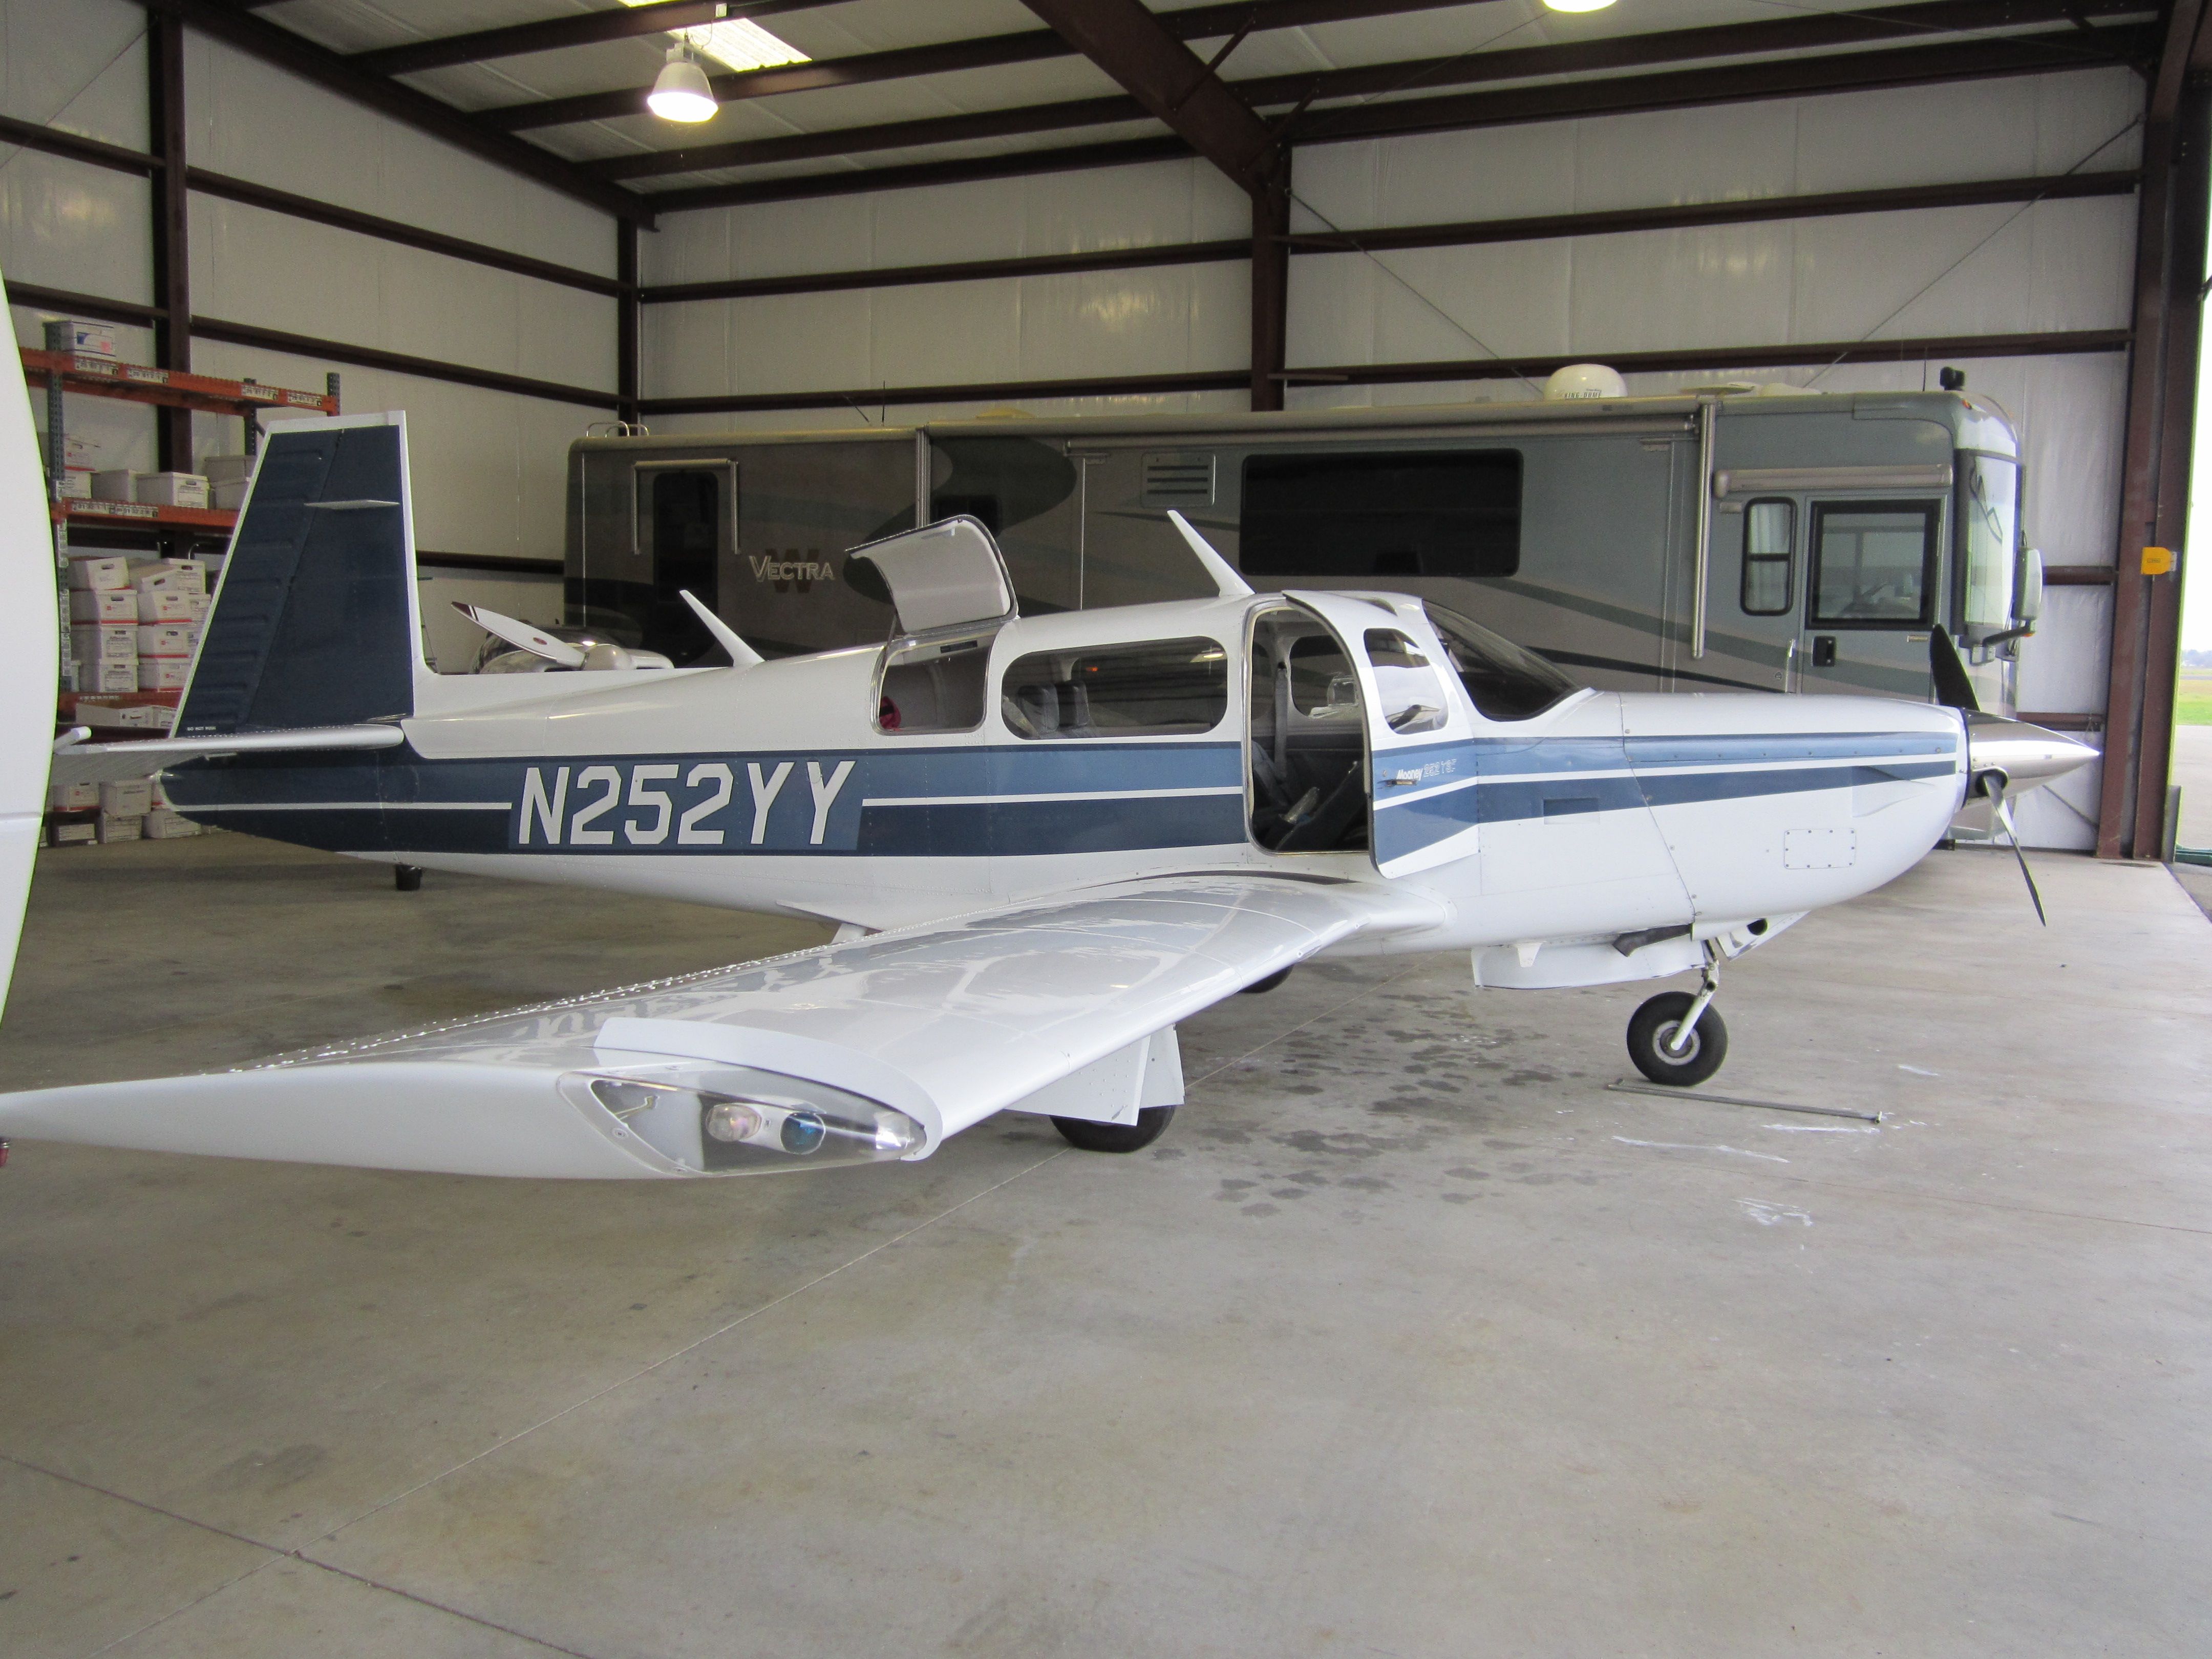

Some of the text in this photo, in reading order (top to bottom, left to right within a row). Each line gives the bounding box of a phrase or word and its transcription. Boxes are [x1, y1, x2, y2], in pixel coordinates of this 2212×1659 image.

[749, 555, 836, 582] VECTRA
[1396, 768, 1423, 781] Mooney
[518, 761, 856, 844] N252YY
